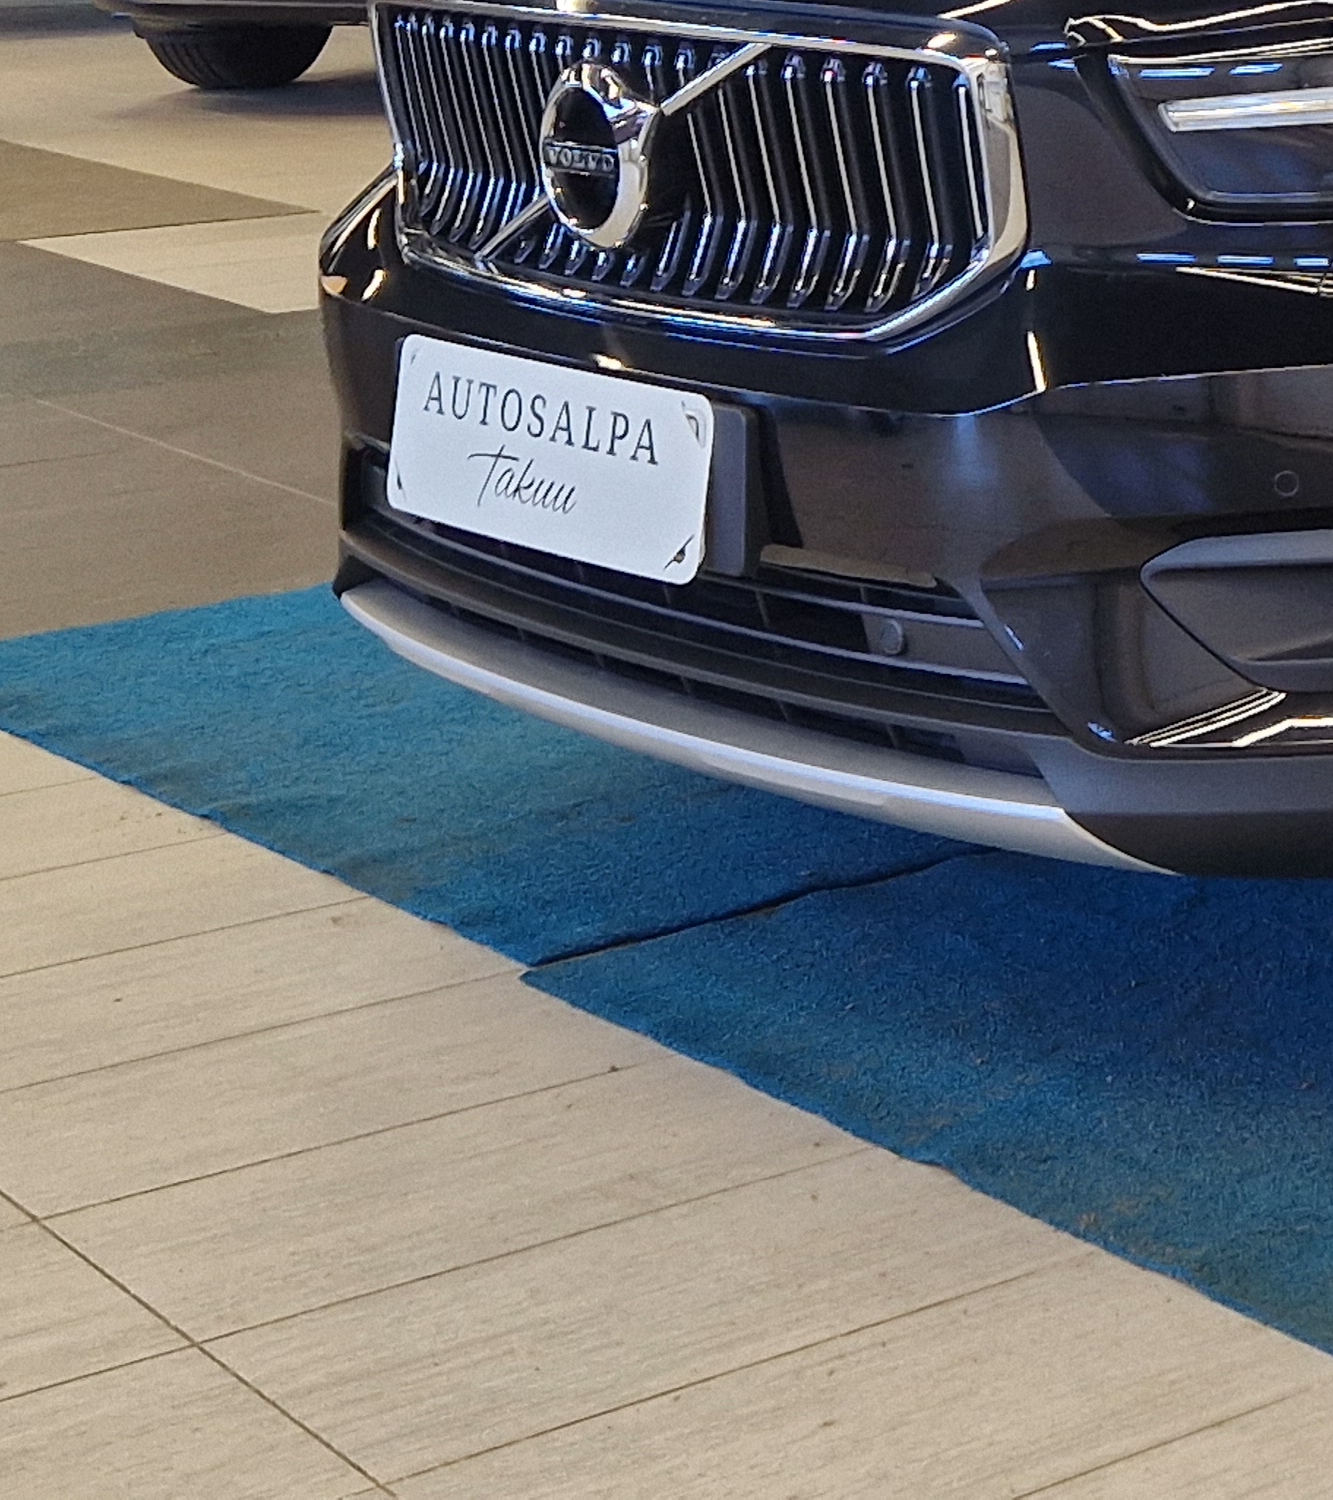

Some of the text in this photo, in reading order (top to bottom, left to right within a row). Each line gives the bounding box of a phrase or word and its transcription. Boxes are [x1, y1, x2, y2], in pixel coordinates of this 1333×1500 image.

[548, 146, 615, 173] VOLVO
[424, 371, 659, 466] AUTOSALPA
[467, 444, 577, 514] Takuu
